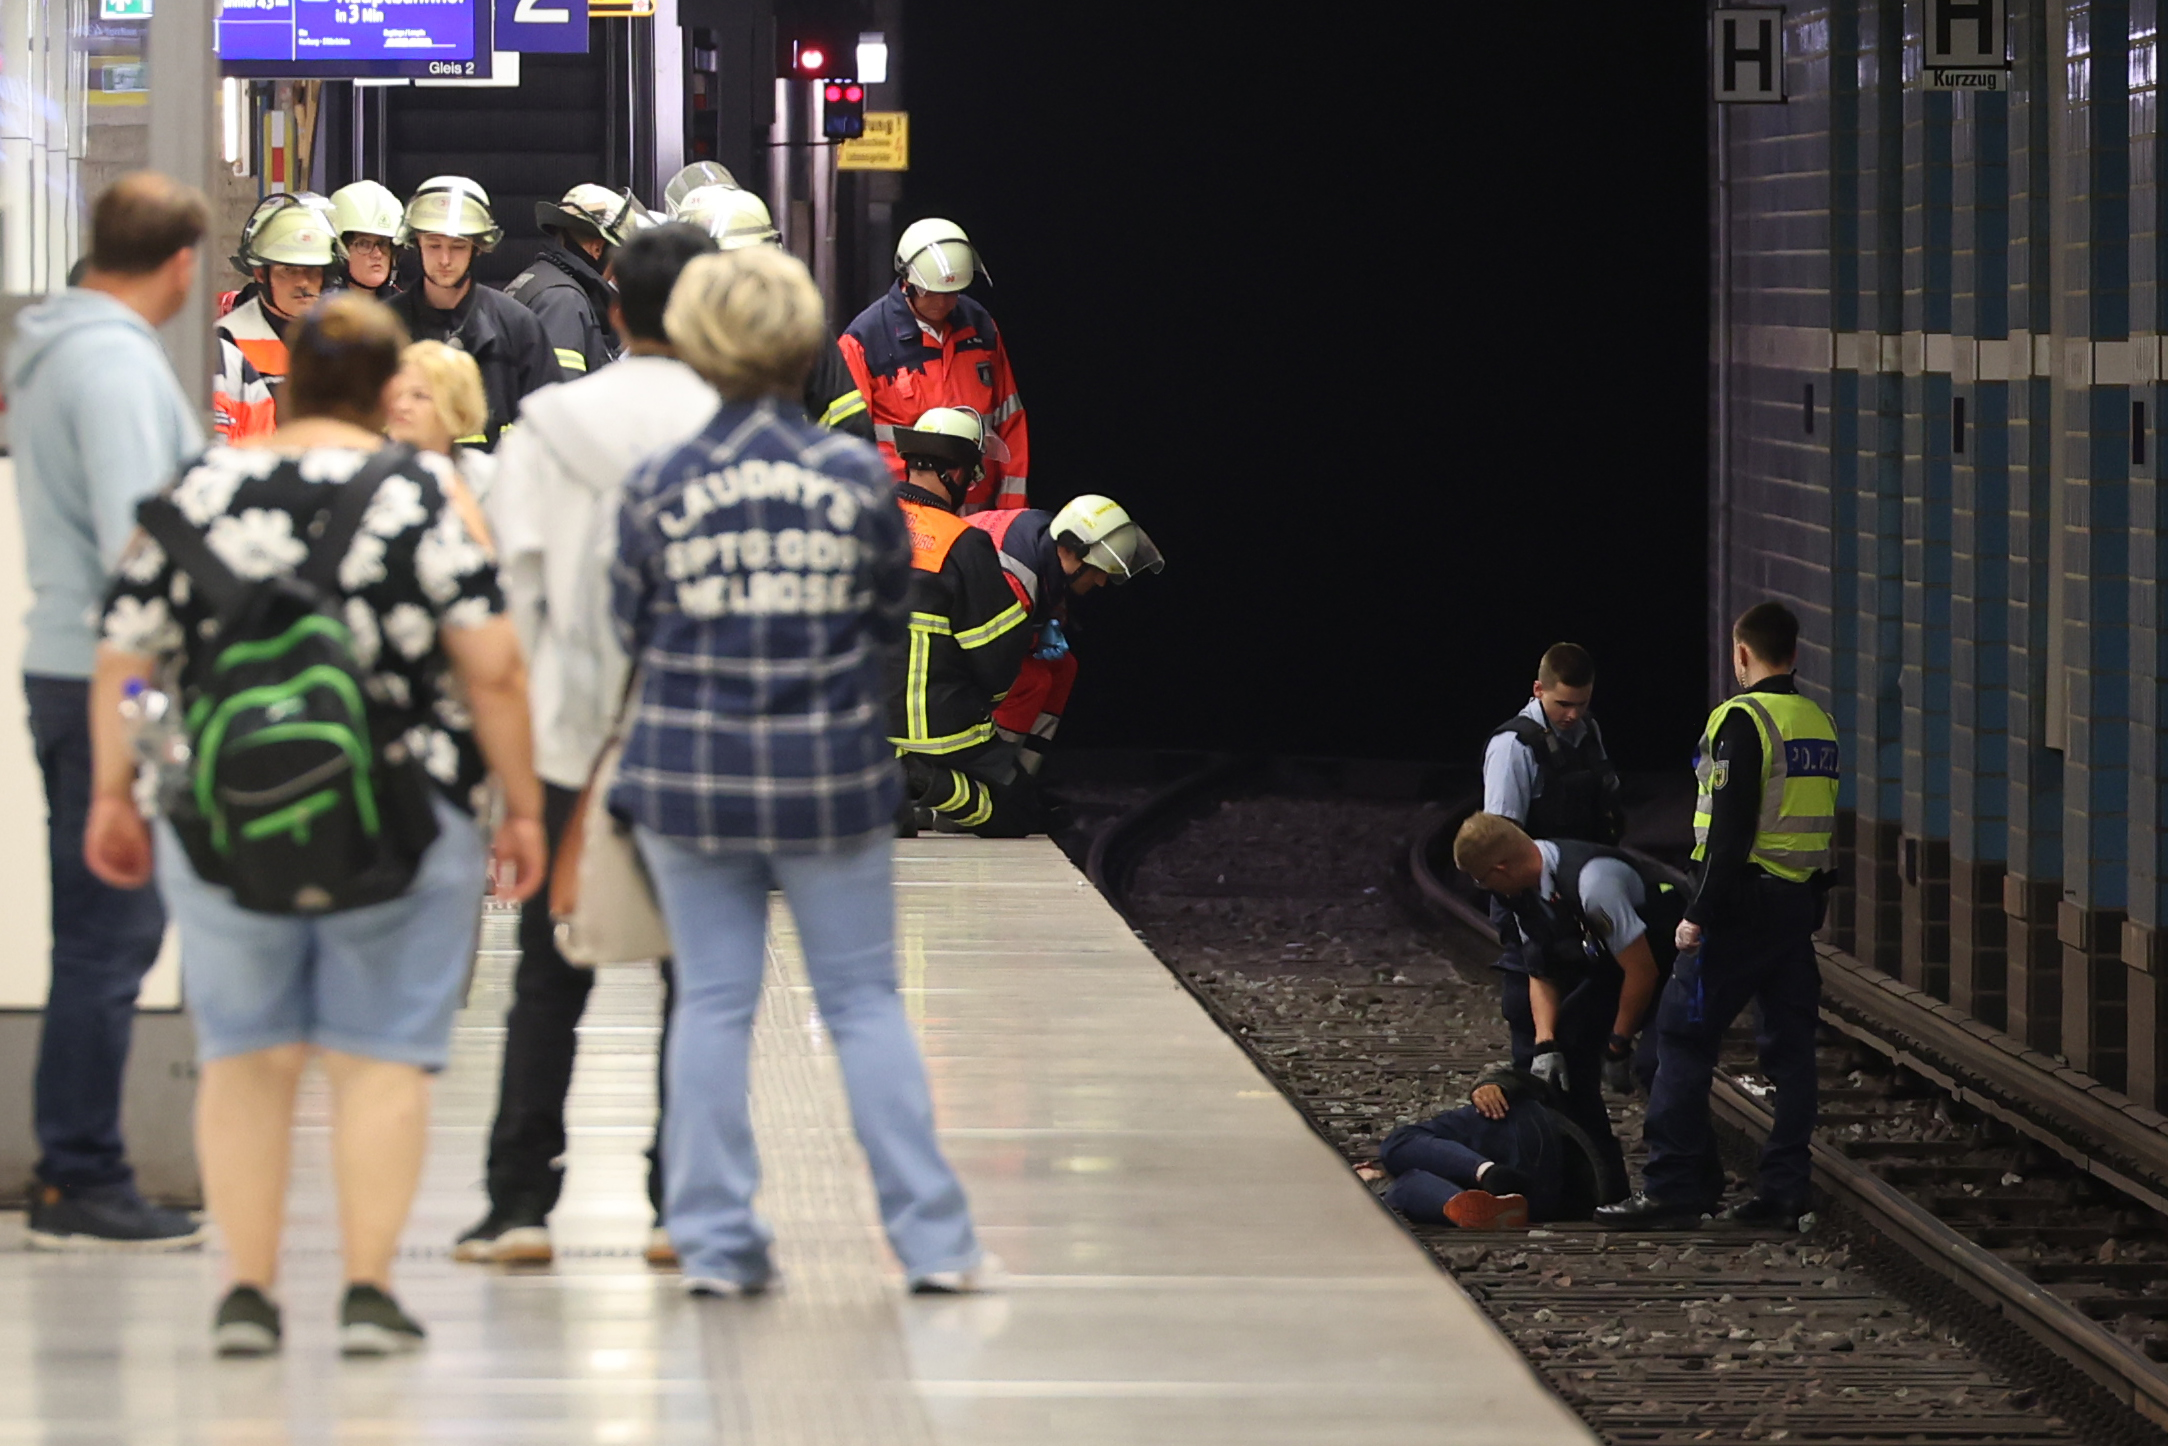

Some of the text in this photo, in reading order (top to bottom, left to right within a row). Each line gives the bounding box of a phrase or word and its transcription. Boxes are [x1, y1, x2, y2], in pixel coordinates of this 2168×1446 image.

[335, 9, 347, 23] in
[348, 4, 360, 24] 3
[362, 8, 385, 23] Min
[1935, 0, 1993, 55] H
[1723, 19, 1772, 91] H
[429, 61, 475, 74] Gleis 2
[1933, 69, 1997, 90] Kurzzug
